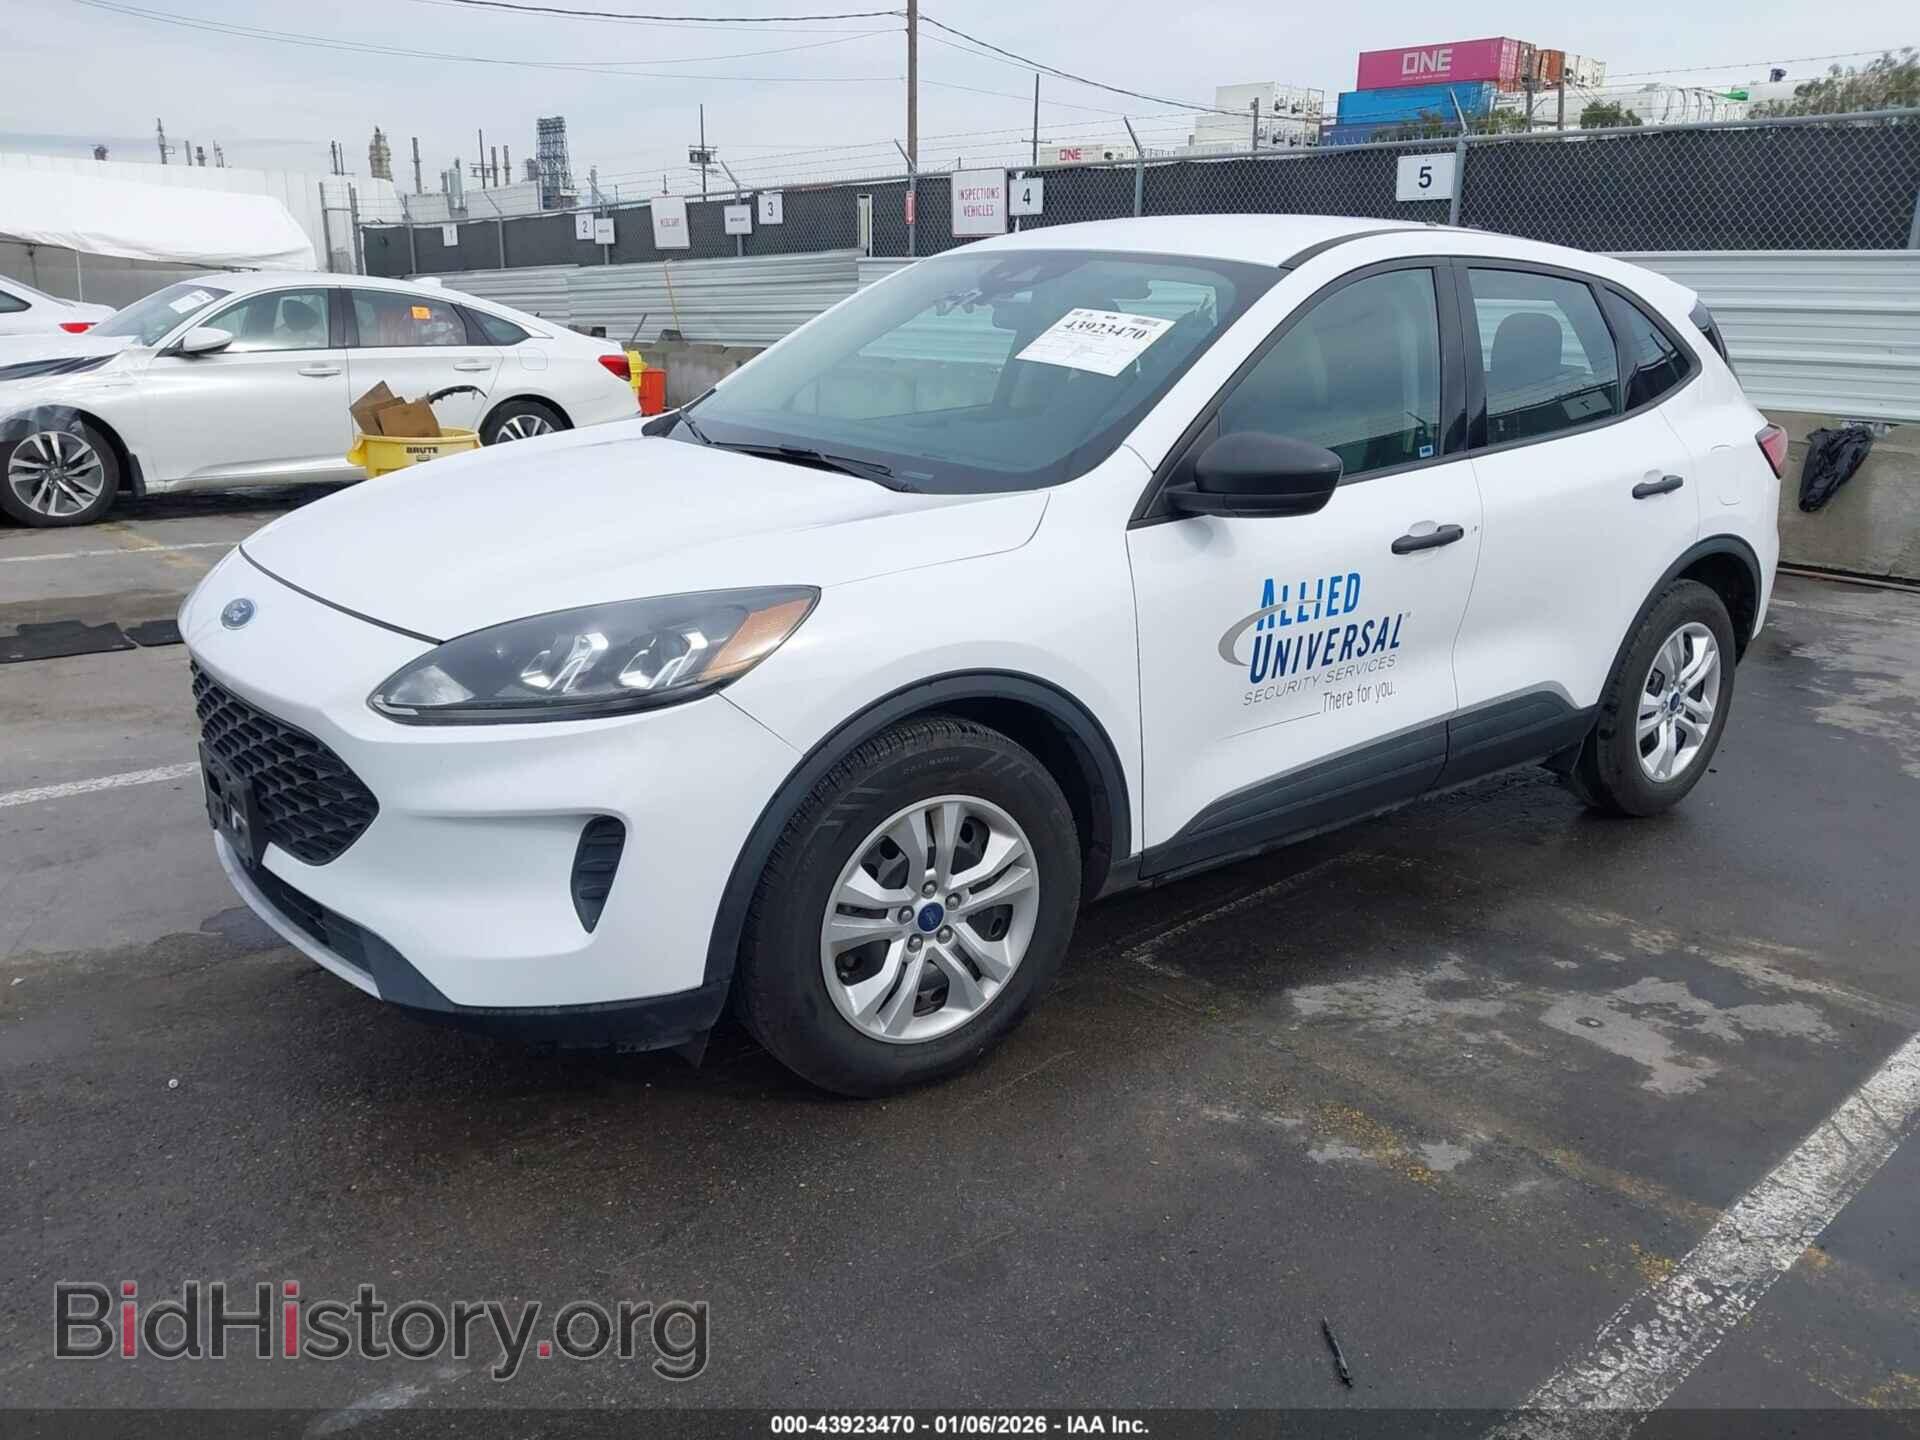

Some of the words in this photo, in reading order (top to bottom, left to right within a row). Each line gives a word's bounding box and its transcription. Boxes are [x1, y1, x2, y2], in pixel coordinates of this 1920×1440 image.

[1402, 49, 1453, 74] ONE
[1059, 148, 1082, 161] ONE
[1417, 165, 1433, 189] 5
[1022, 188, 1031, 205] 4
[767, 201, 774, 217] 3
[963, 204, 995, 217] VEHICLES
[582, 220, 588, 233] 2
[1064, 319, 1147, 339] 43923470
[406, 446, 438, 454] BRUTE
[1256, 572, 1361, 631] ALLIED
[1250, 613, 1402, 684] UNIVERSAL
[1243, 674, 1320, 706] SECURITY
[1325, 654, 1397, 684] SERVICES
[1323, 691, 1353, 712] There
[1357, 684, 1372, 703] for
